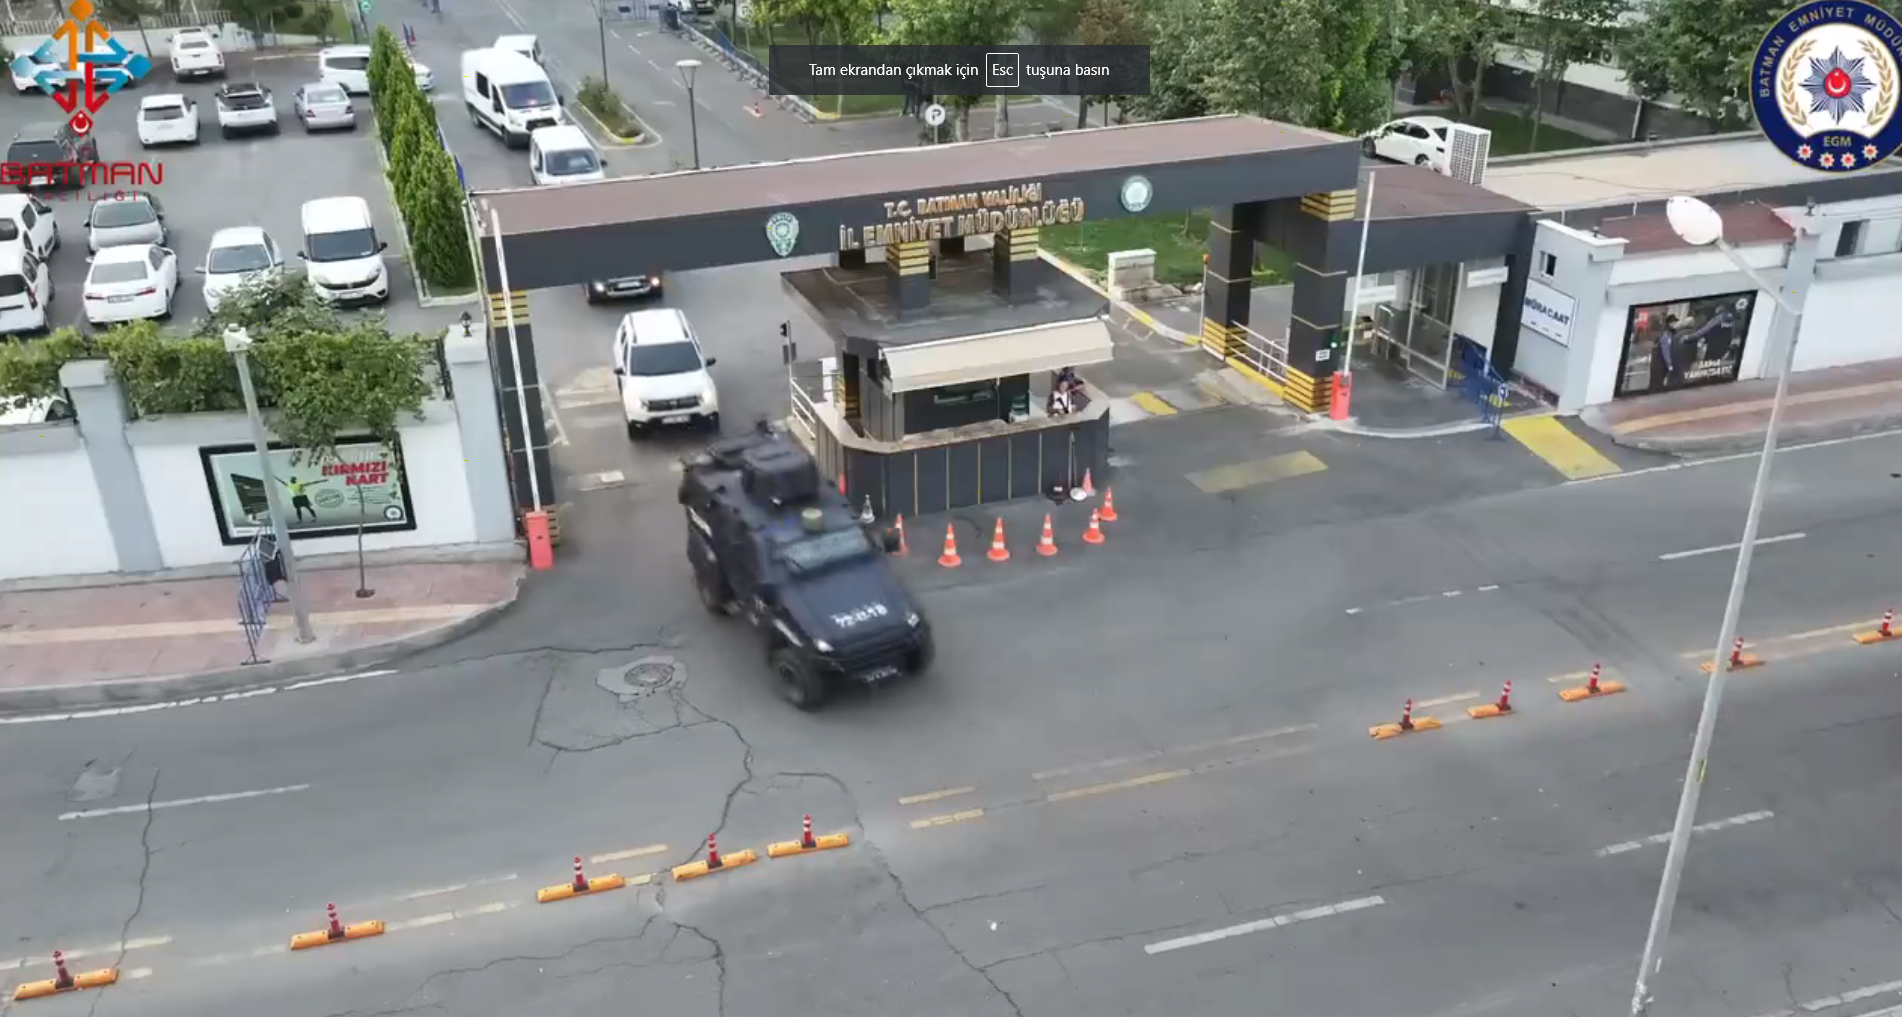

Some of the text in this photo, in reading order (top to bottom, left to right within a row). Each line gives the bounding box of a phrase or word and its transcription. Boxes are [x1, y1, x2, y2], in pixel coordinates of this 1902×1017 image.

[839, 197, 1086, 251] İL EMNİYET MÜDÜRLÜĞÜ
[321, 460, 387, 477] KIRMIZI
[345, 472, 388, 486] KART
